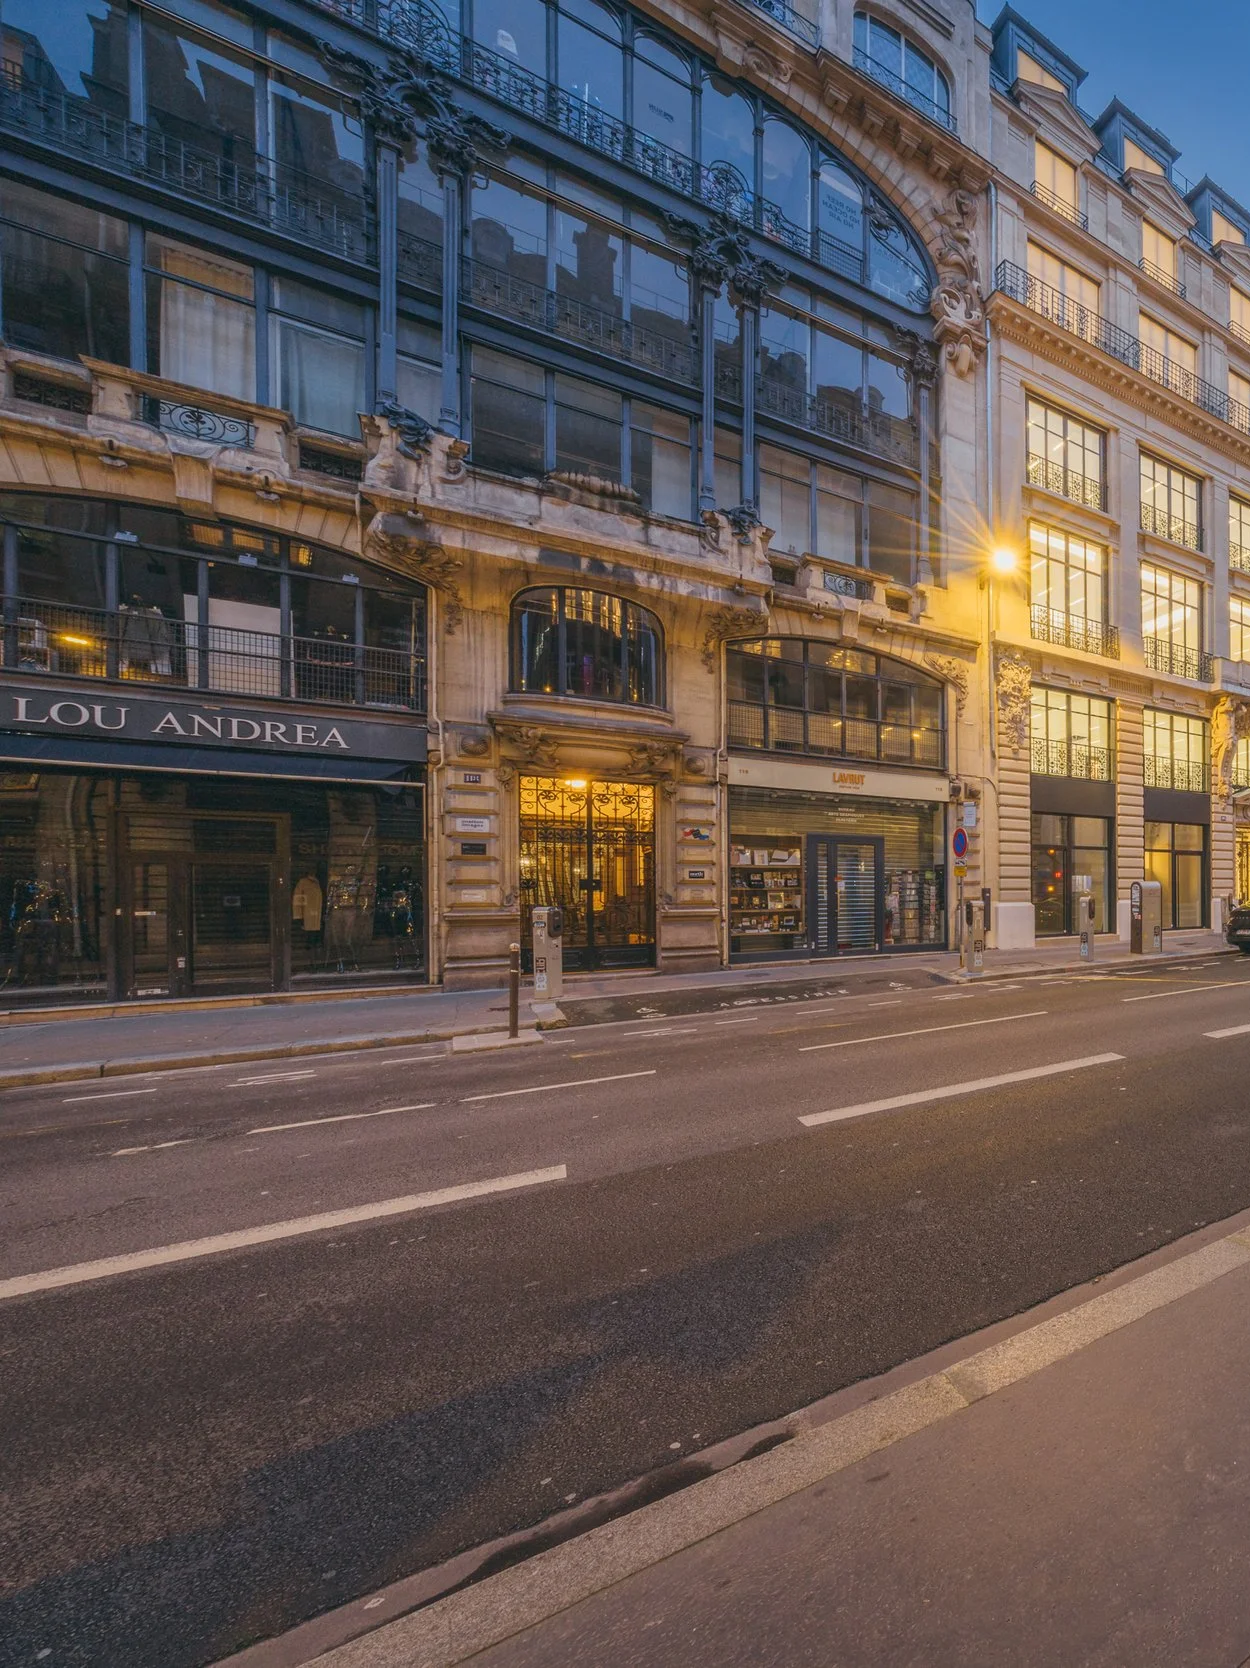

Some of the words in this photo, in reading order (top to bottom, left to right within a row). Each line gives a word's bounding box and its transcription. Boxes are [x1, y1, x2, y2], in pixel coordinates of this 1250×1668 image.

[12, 697, 131, 730] LOU
[150, 711, 351, 749] ANDREA
[832, 771, 865, 785] LAVRUT
